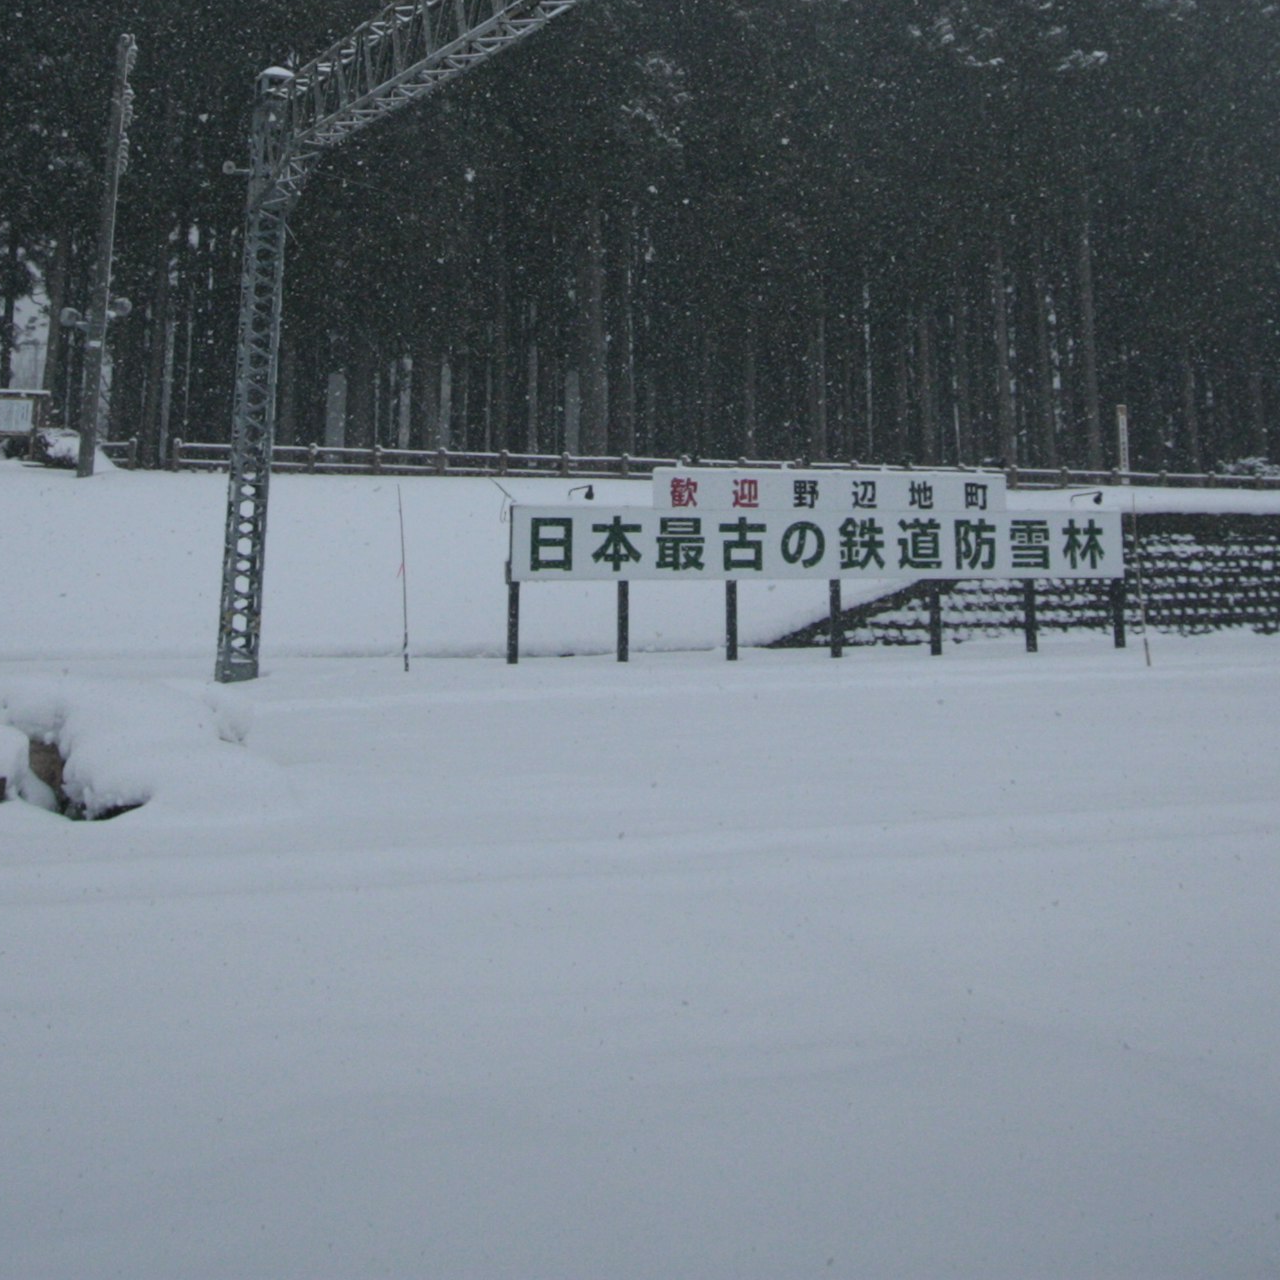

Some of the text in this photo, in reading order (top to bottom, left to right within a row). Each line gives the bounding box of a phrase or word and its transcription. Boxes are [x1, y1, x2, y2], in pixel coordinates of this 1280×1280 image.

[670, 477, 988, 510] 歓迎野辺地町
[530, 515, 1105, 571] 日本最古の鉄道防雪林
